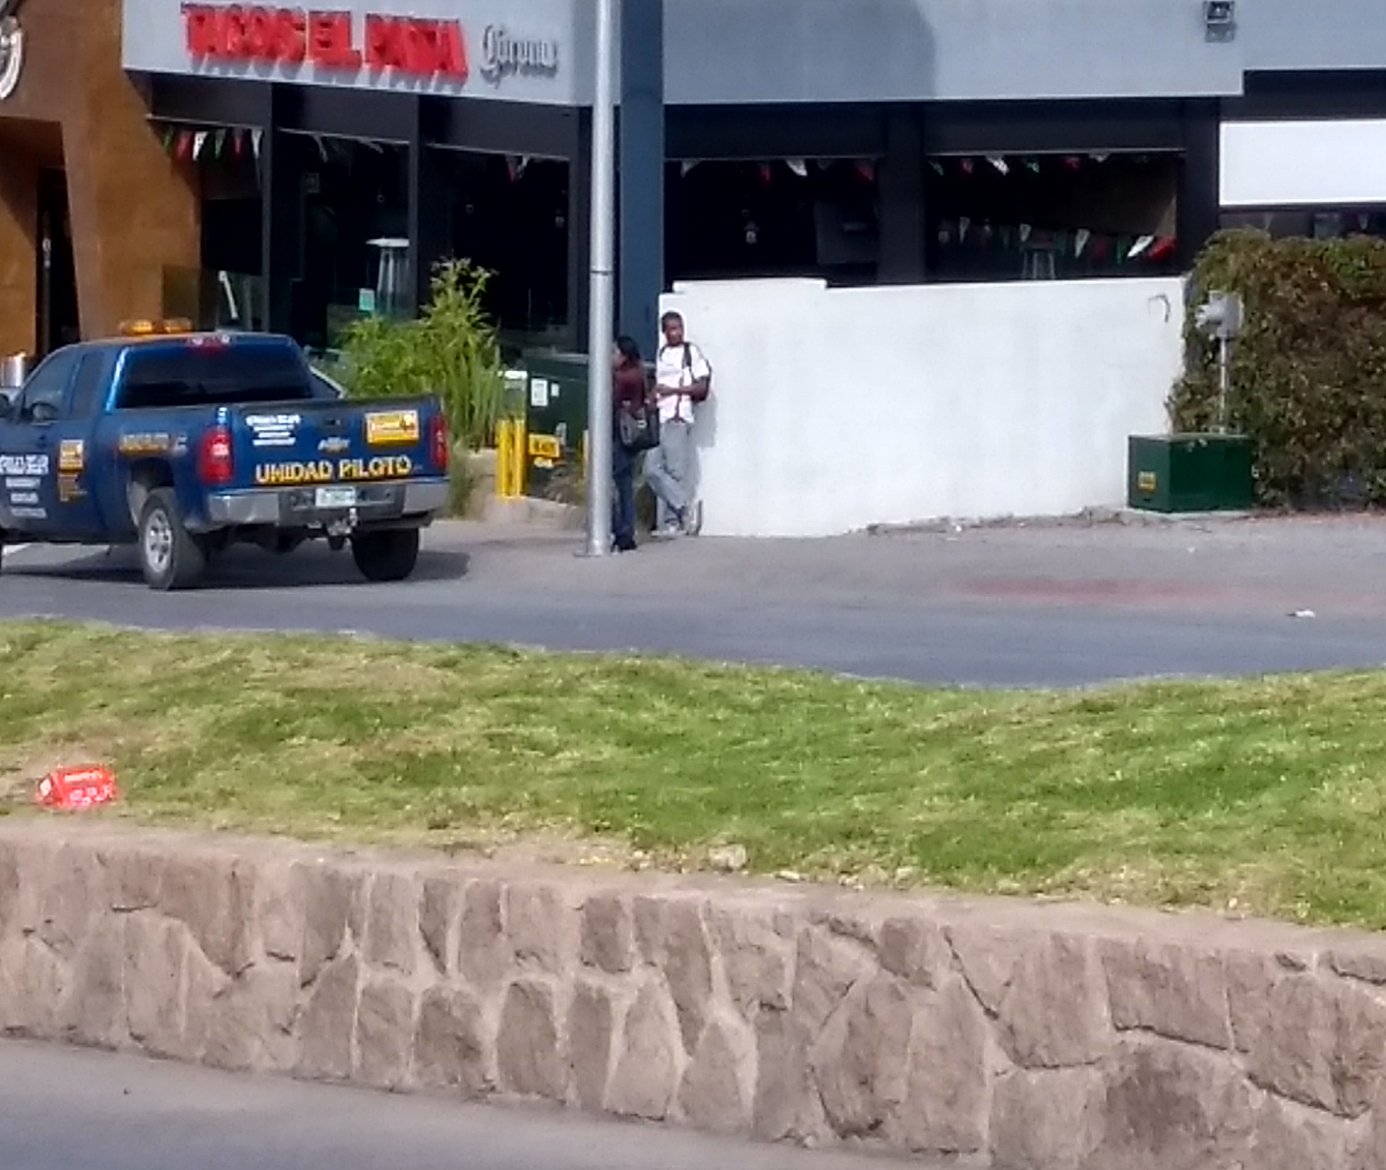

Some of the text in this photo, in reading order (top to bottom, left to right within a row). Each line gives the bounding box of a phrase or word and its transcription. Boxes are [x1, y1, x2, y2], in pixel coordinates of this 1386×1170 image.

[308, 10, 362, 71] EL
[255, 455, 412, 484] UNIDAD PILOTO
